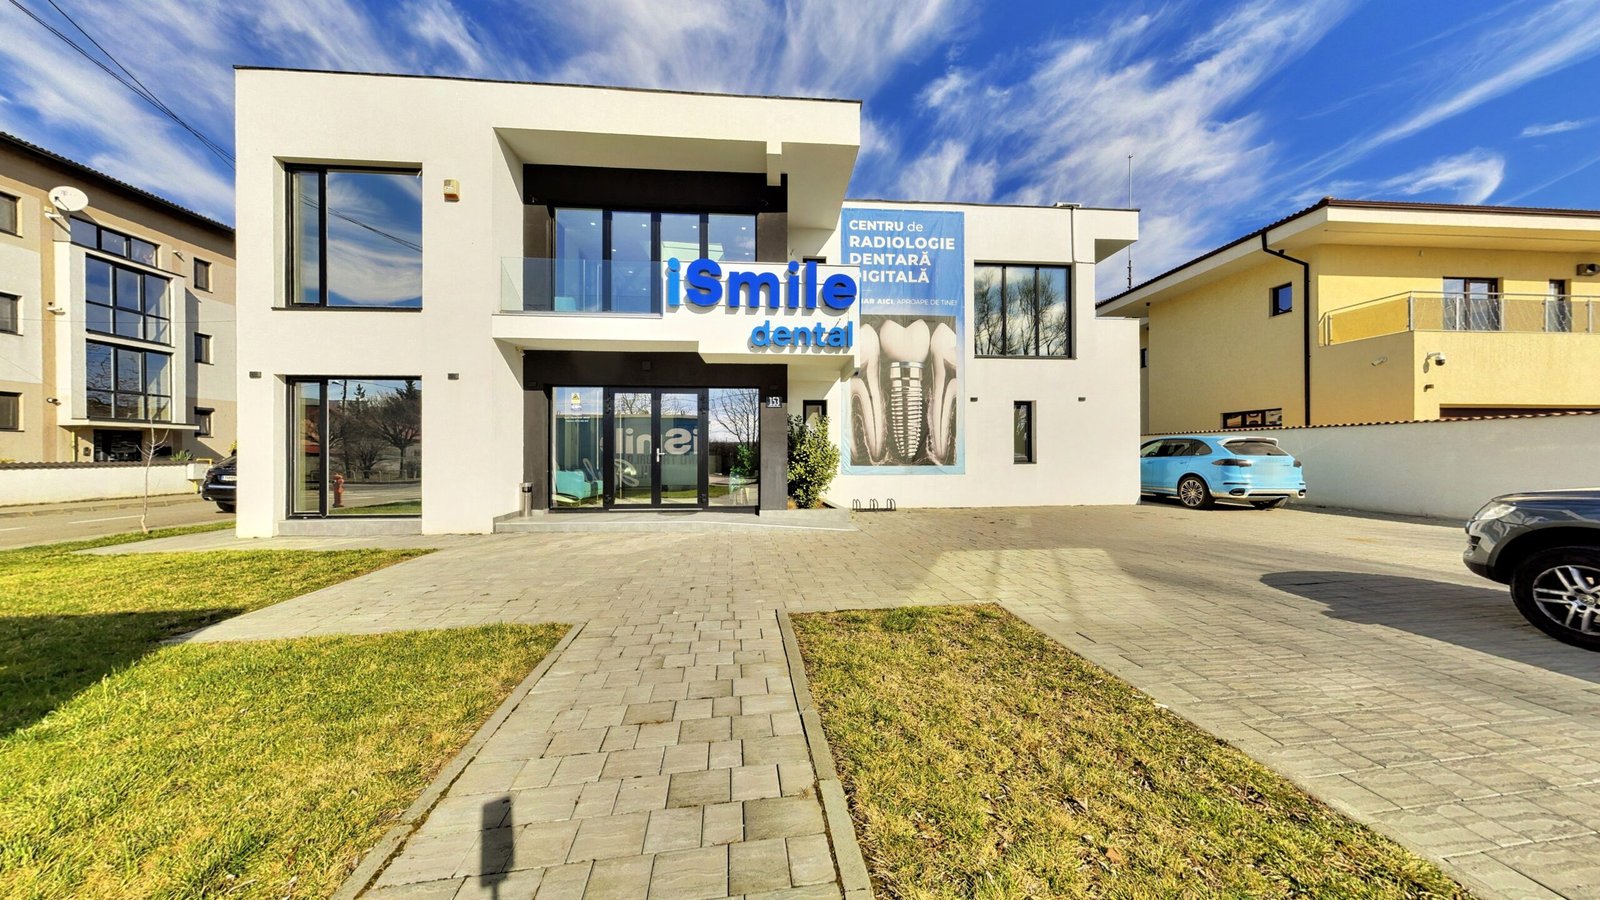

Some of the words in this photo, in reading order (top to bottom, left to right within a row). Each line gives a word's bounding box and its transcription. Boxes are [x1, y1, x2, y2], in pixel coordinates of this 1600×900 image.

[849, 219, 904, 232] CENTRU
[907, 221, 924, 232] de
[849, 235, 955, 250] RADIOLOGIE
[849, 250, 931, 266] DENTARĂ
[667, 257, 857, 310] iSmile
[859, 267, 930, 284] IGITALĂ
[896, 298, 929, 306] APROAPE
[751, 319, 853, 348] dental
